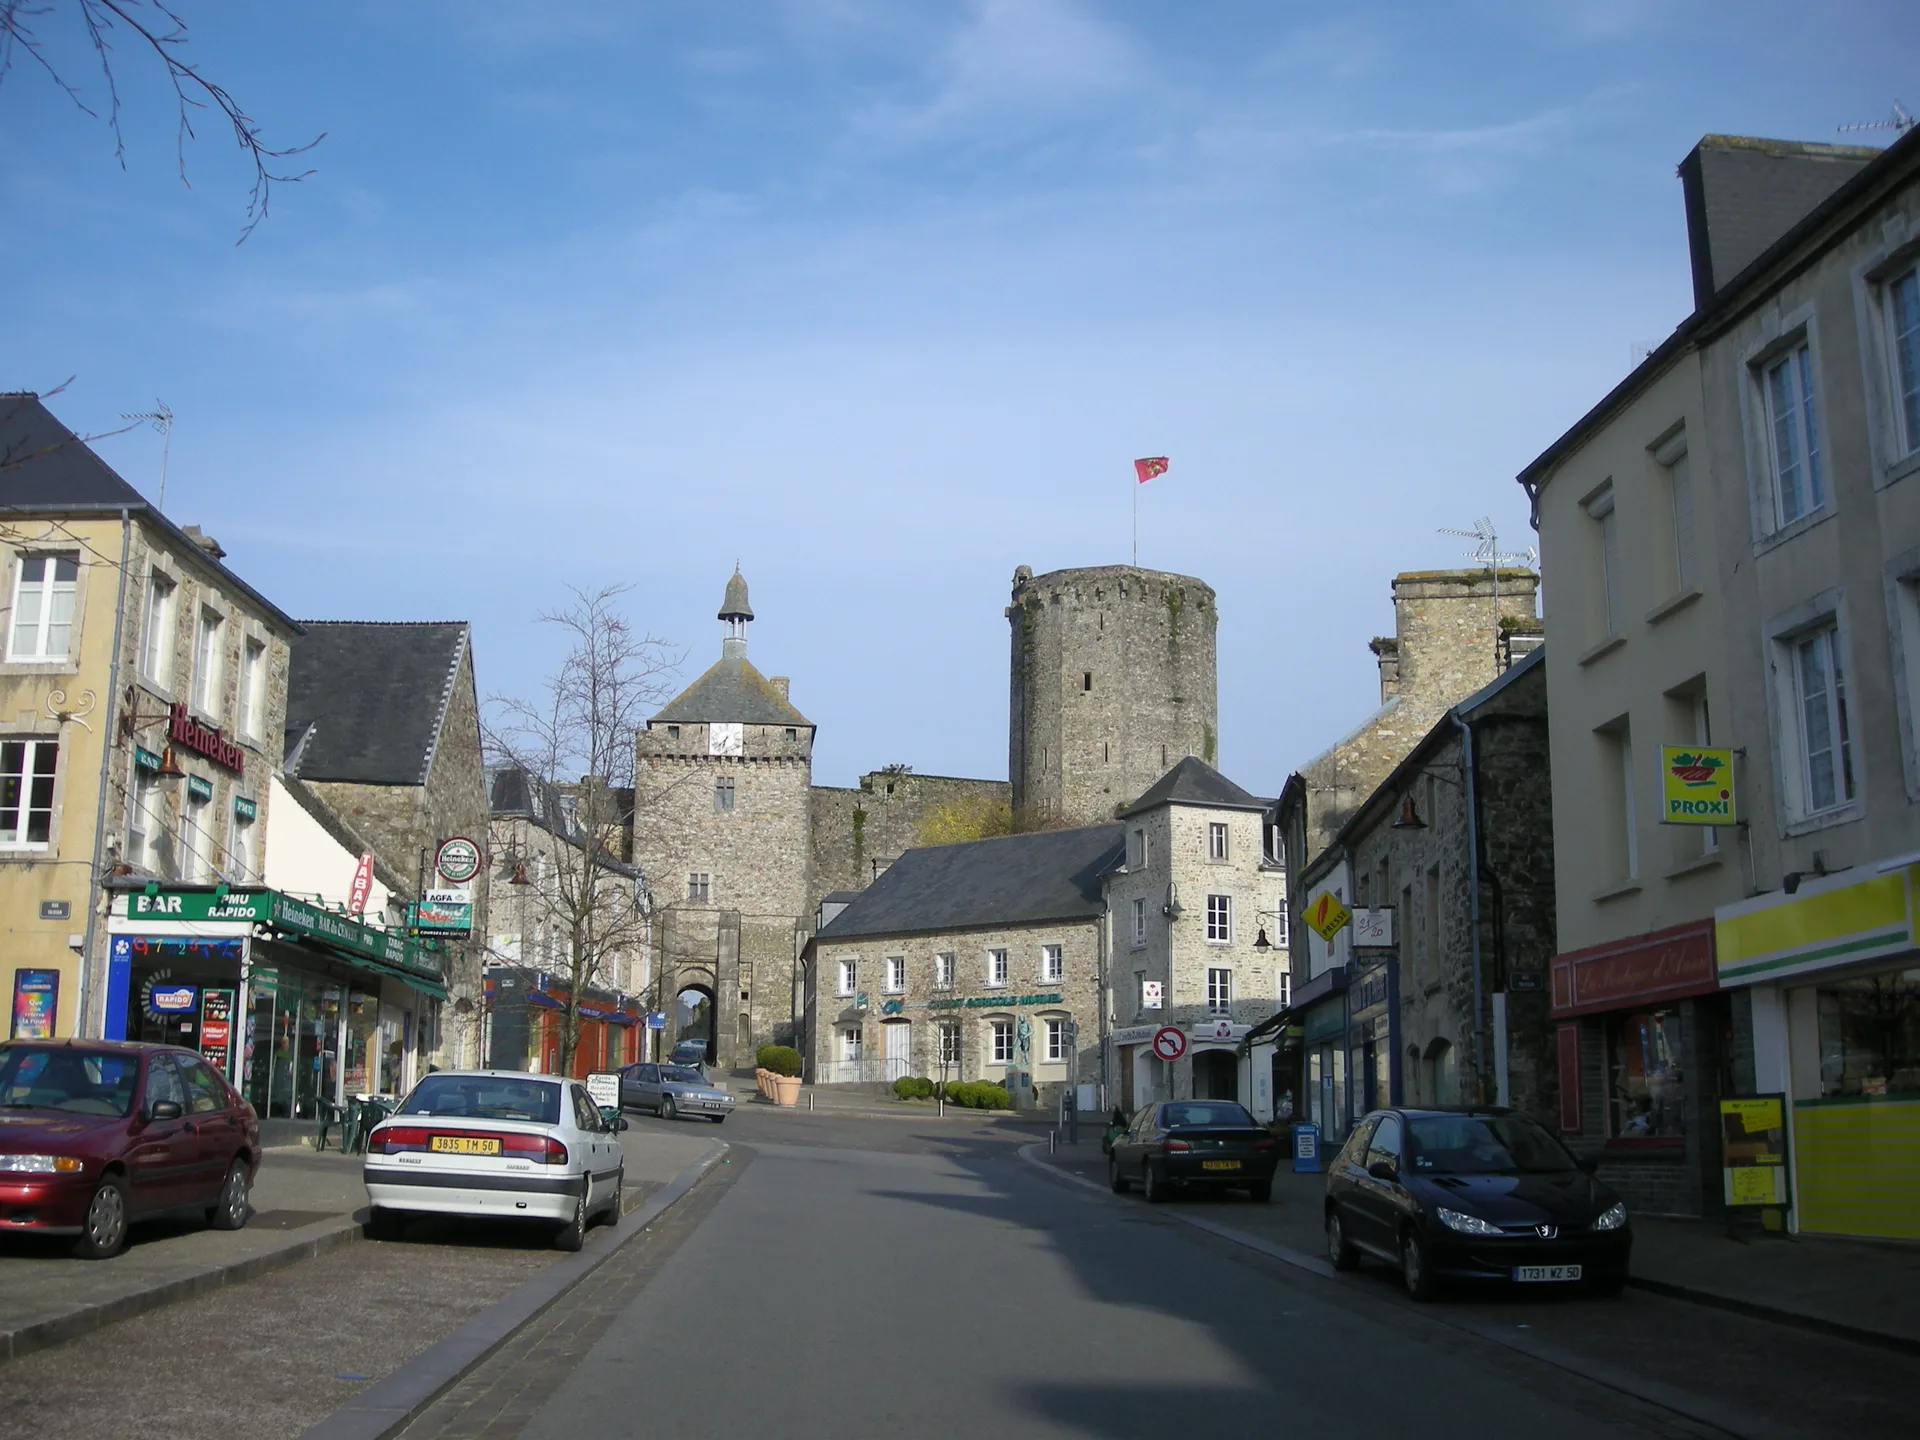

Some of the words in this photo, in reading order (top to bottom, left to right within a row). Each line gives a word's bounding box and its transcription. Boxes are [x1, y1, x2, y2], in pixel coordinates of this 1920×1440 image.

[171, 703, 245, 772] Heineken
[237, 801, 254, 815] PMU
[1670, 796, 1729, 814] PROXI
[441, 854, 475, 864] Heineken
[351, 854, 371, 912] TABAC
[136, 894, 183, 913] BAR
[220, 894, 250, 904] PMU
[430, 894, 453, 902] AGFA
[207, 906, 256, 918] RAPIDO
[282, 900, 315, 929] Heineken
[318, 914, 332, 932] BAR
[363, 933, 373, 946] PMU
[1322, 910, 1348, 936] PRESSE
[387, 936, 404, 950] TABAC
[385, 948, 404, 963] RAPIDO
[159, 995, 189, 1004] RAPIDO
[437, 1138, 460, 1150] 3835
[466, 1140, 479, 1151] TM
[482, 1140, 494, 1151] 50
[1522, 1268, 1545, 1279] 1731
[1551, 1267, 1563, 1279] WZ
[1566, 1267, 1579, 1278] 50
